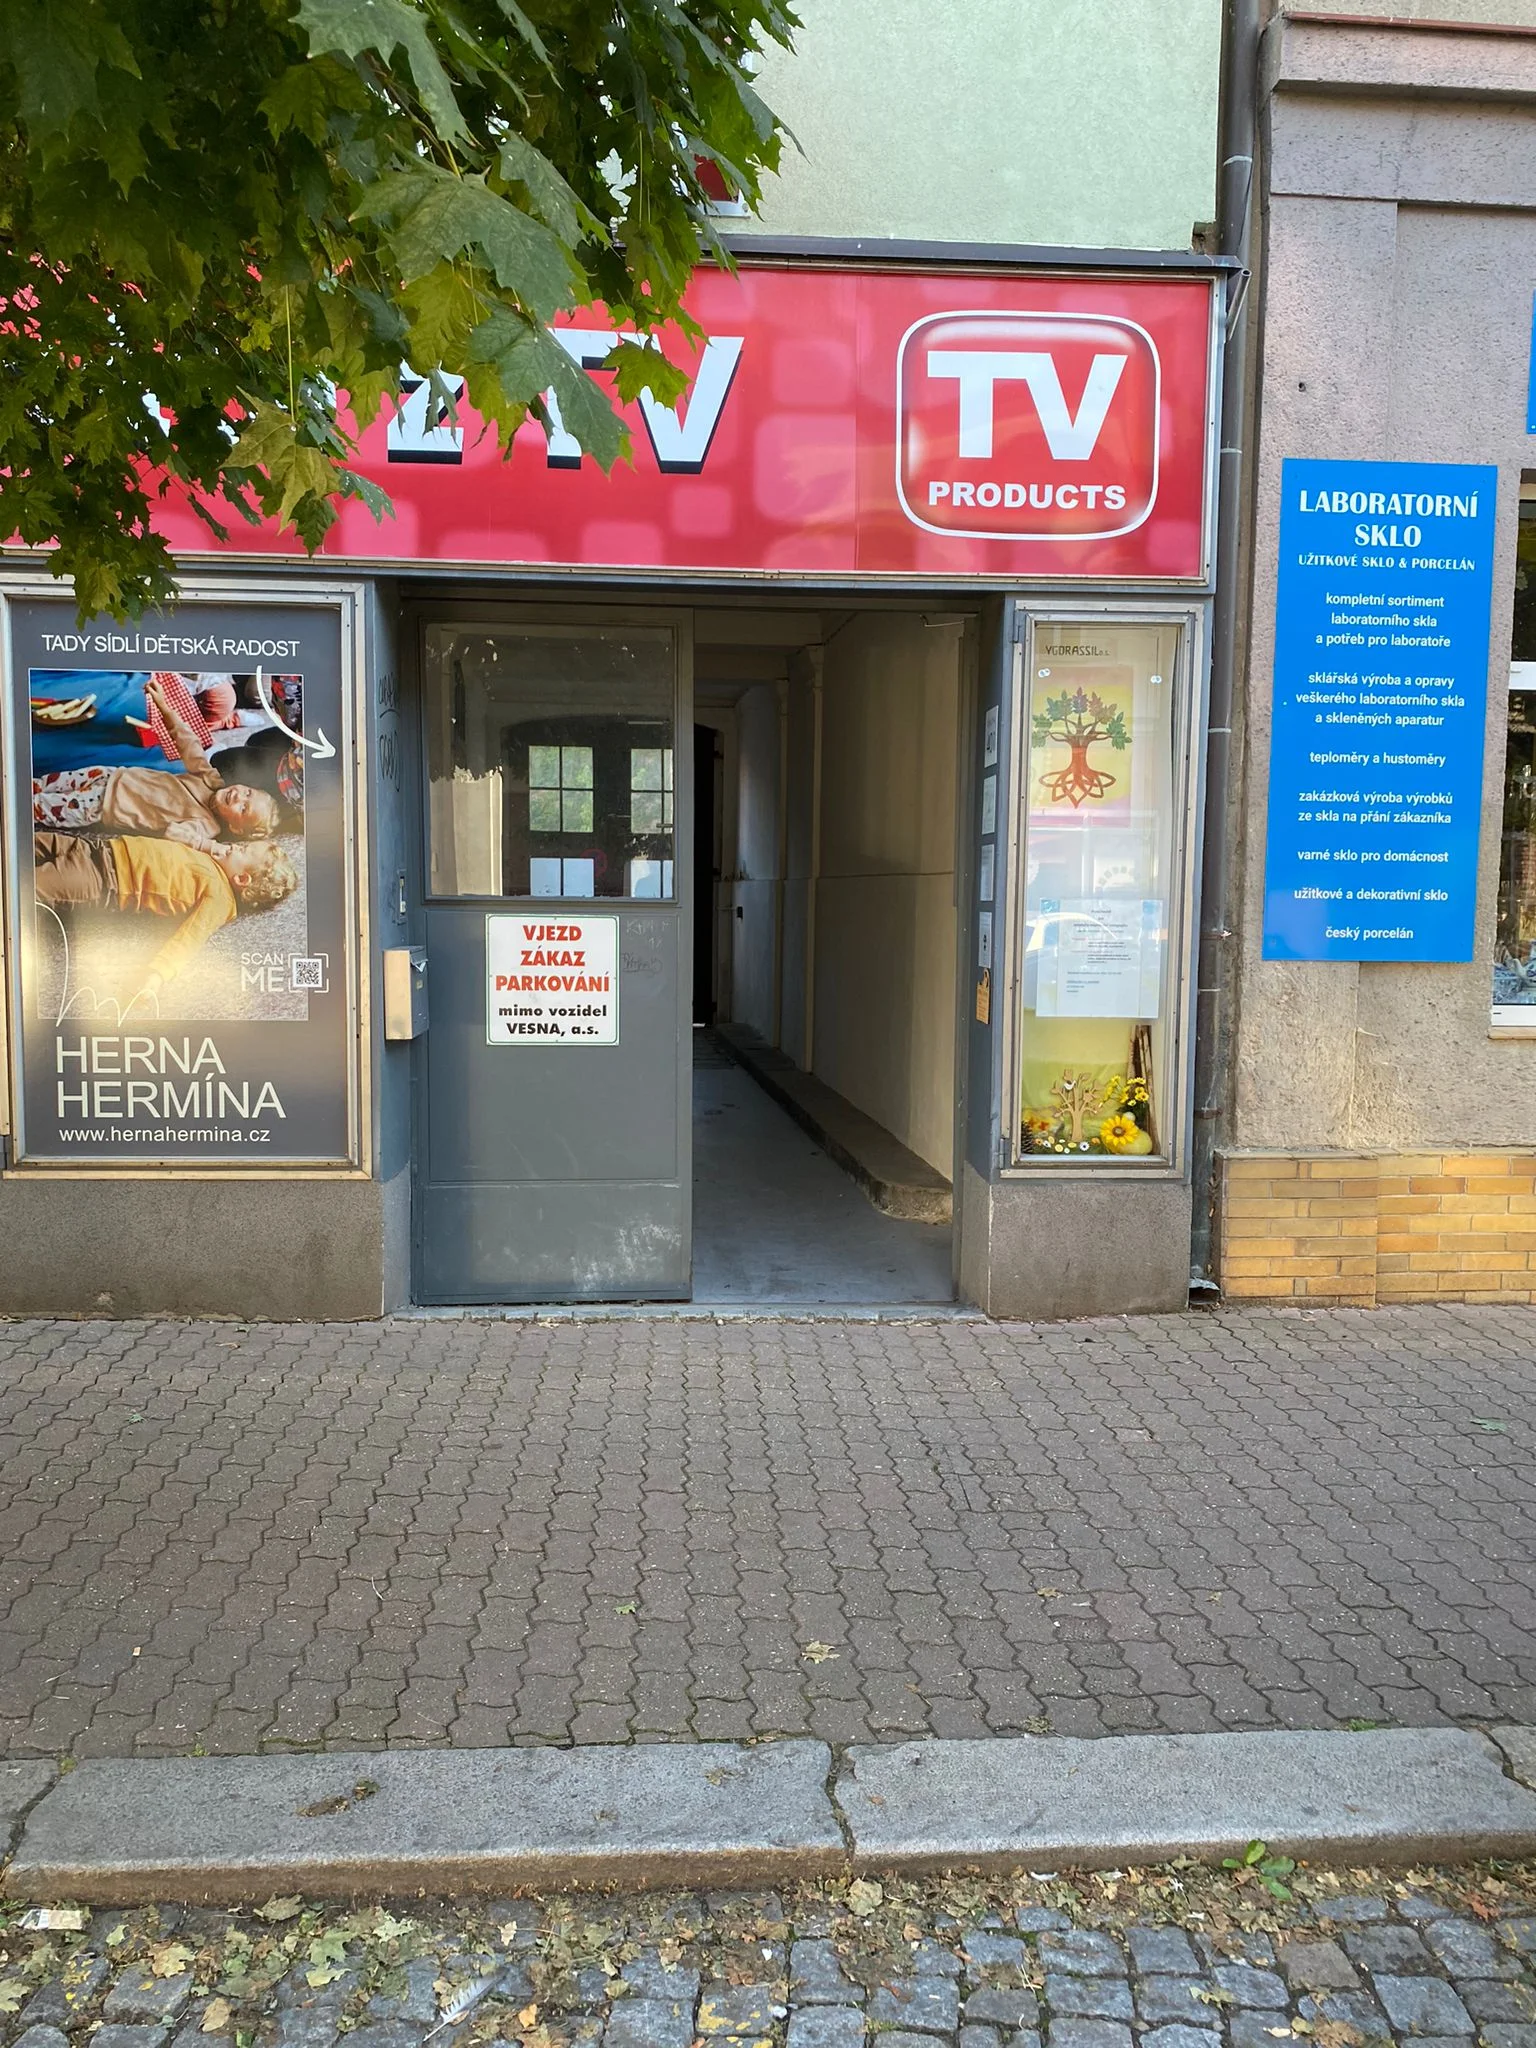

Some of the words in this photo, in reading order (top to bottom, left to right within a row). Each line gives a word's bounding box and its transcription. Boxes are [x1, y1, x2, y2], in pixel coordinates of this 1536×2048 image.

[927, 350, 1128, 460] TV
[928, 481, 1126, 510] PRODUCTS
[1300, 490, 1478, 518] LABORATORNÍ
[1355, 524, 1422, 547] SKLO
[1298, 553, 1358, 568] UŽITKOVÉ
[1362, 557, 1395, 569] SKLO
[1398, 558, 1408, 569] &
[1411, 556, 1476, 571] PORCELÁN
[1326, 592, 1384, 608] kompletní
[1387, 594, 1444, 607] sortiment
[1331, 612, 1410, 627] laboratorního
[1414, 614, 1437, 627] skla
[42, 634, 92, 653] TADY
[94, 632, 141, 655] SÍDLÍ
[144, 632, 220, 657] DĚTSKÁ
[222, 638, 301, 658] RADOST
[1315, 634, 1323, 645] a
[1326, 632, 1365, 649] potřeb
[1368, 636, 1388, 650] pro
[1391, 634, 1451, 648] laboratoře
[1308, 671, 1358, 686] sklářská
[1361, 673, 1401, 688] výroba
[1404, 677, 1412, 687] a
[1415, 677, 1455, 690] opravy
[1296, 690, 1357, 706] veškerého
[1359, 692, 1438, 707] laboratorního
[1441, 694, 1465, 708] skla
[1315, 714, 1323, 724] a
[1325, 711, 1392, 728] skleněných
[1395, 715, 1445, 729] aparatur
[1310, 750, 1370, 767] teploměry
[1372, 754, 1380, 765] a
[1383, 752, 1446, 769] hustoměry
[1298, 789, 1360, 803] zakázková
[1363, 791, 1403, 806] výroba
[1406, 790, 1453, 806] výrobků
[1298, 811, 1312, 822] ze
[1315, 810, 1339, 822] skla
[1342, 813, 1357, 823] na
[1360, 810, 1390, 825] přání
[1393, 810, 1451, 824] zákazníka
[1297, 848, 1331, 862] varné
[1333, 849, 1358, 862] sklo
[1361, 852, 1381, 865] pro
[1383, 849, 1449, 863] domácnost
[1294, 886, 1343, 901] užitkové
[1346, 889, 1353, 900] a
[1356, 887, 1421, 901] dekorativní
[1423, 889, 1448, 902] sklo
[523, 925, 582, 941] VJEZD
[1325, 925, 1360, 942] český
[1363, 925, 1414, 942] porcelán
[241, 952, 284, 966] SCAN
[520, 945, 585, 967] ZÁKAZ
[241, 967, 284, 992] ME
[495, 971, 609, 992] PARKOVÁNÍ
[498, 1004, 543, 1017] mimo
[548, 1004, 607, 1017] vozidel
[506, 1022, 566, 1037] VESNA,
[571, 1026, 599, 1035] a.s.
[56, 1036, 226, 1073] HERNA
[57, 1073, 287, 1119] HERMÍNA
[58, 1125, 271, 1143] www.hernahermina.cz
